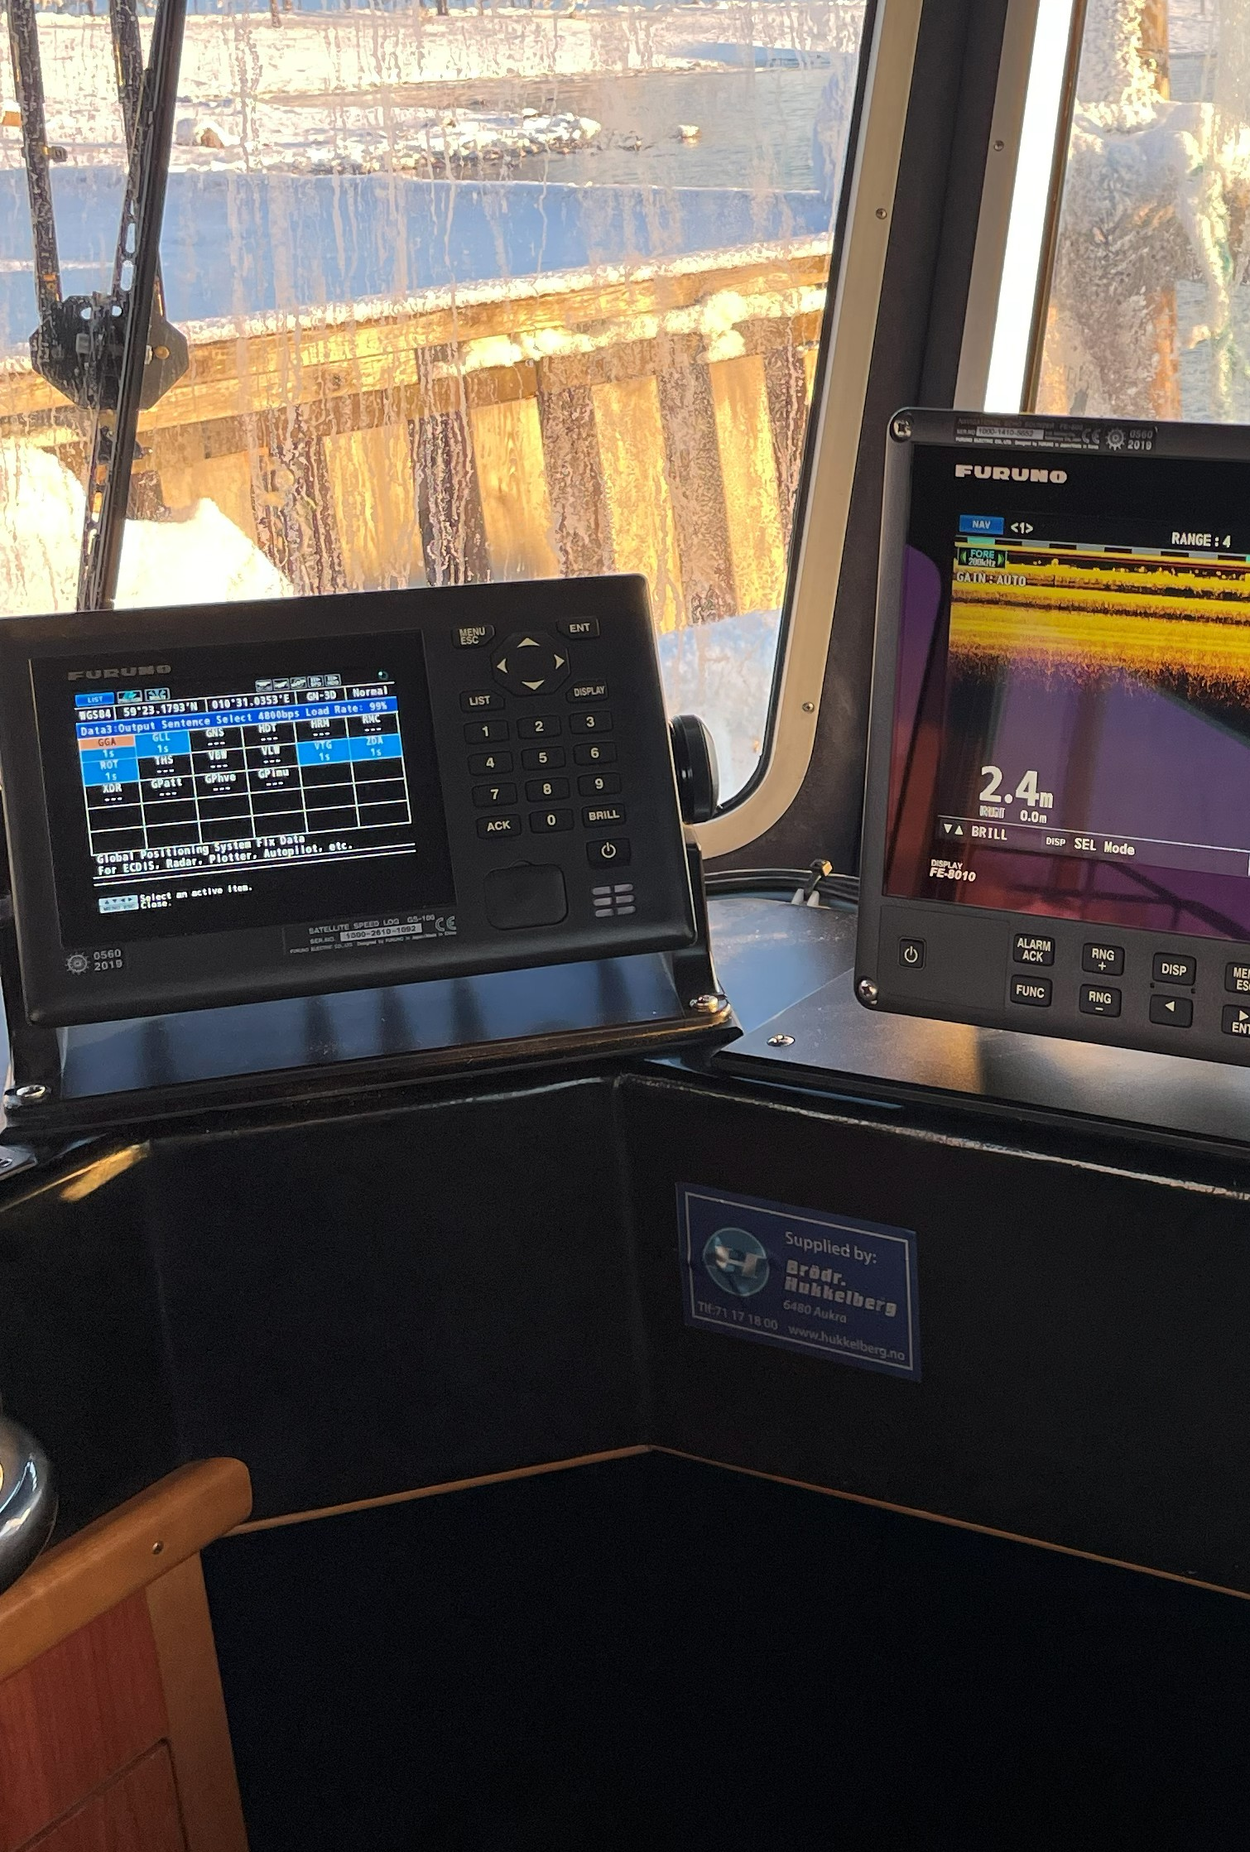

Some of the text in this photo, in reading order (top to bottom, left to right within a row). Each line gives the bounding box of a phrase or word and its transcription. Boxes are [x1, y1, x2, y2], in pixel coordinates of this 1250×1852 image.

[1127, 439, 1152, 451] 2019
[955, 464, 1068, 484] FURUNO
[972, 520, 991, 530] NAV
[970, 550, 995, 559] FORE
[459, 627, 486, 637] MENU
[569, 623, 591, 633] ENT
[460, 636, 479, 645] ESC
[67, 665, 171, 681] FURUNO
[306, 690, 336, 701] GN-3D
[352, 685, 387, 697] Normal
[574, 686, 605, 697] DISPLAY
[87, 696, 103, 704] LIST
[469, 695, 490, 706] LIST
[161, 716, 211, 729] Sentence
[216, 713, 253, 724] Select
[258, 709, 300, 721] 4800bps
[305, 705, 330, 717] Load
[369, 702, 387, 711] 99%
[586, 716, 595, 727] 3
[98, 737, 117, 747] GGA
[152, 732, 170, 742] GLL
[205, 728, 225, 738] GNS
[258, 724, 277, 734] HDT
[362, 714, 381, 724] RMC
[482, 726, 489, 737] 1
[535, 720, 544, 732] 2
[100, 760, 118, 770] ROT
[155, 755, 174, 766] THS
[261, 745, 281, 756] VLW
[314, 740, 332, 750] VTG
[366, 736, 384, 746] ZDA
[102, 744, 169, 758] 1s 1s
[590, 747, 599, 758] 6
[485, 757, 495, 768] 4
[539, 752, 547, 763] 5
[105, 748, 382, 781] 1s 1s 1s
[102, 783, 123, 794] XDR
[150, 777, 182, 789] GPatt
[543, 783, 552, 795] 8
[595, 778, 604, 789] 9
[491, 788, 499, 800] 7
[547, 814, 556, 826] 0
[588, 810, 620, 821] BRILL
[1020, 809, 1047, 824] 0.0m
[487, 820, 511, 832] ACK
[971, 825, 1135, 856] BRILL DISP SEL Mode
[97, 835, 305, 865] Global Positioning System Fix Data
[97, 864, 117, 876] For
[166, 856, 203, 869] Radar,
[209, 851, 258, 865] Plotter,
[263, 845, 323, 859] Autopilot,
[328, 841, 353, 851] etc.
[930, 859, 963, 870] DISPLAY
[929, 867, 976, 882] FE-8010
[140, 886, 223, 902] Select active
[140, 901, 171, 909] Close.
[309, 923, 350, 934] SATELLITE
[353, 920, 379, 929] SPEED
[383, 918, 400, 926] LOG
[1017, 938, 1051, 951] ALARM
[93, 949, 122, 960] 0560
[1022, 950, 1043, 962] ACK
[1092, 948, 1115, 961] RNG
[94, 959, 123, 971] 2019
[1161, 963, 1187, 976] DISP
[1016, 984, 1045, 999] FUNC
[1088, 991, 1112, 1004] RNG
[785, 1231, 877, 1265] Supplied by:
[784, 1276, 897, 1318] Hukkelberg
[783, 1300, 847, 1324] 6480 Aukra
[731, 1310, 778, 1330] 17 18 00
[788, 1324, 906, 1361] www.hukkelberg.no
